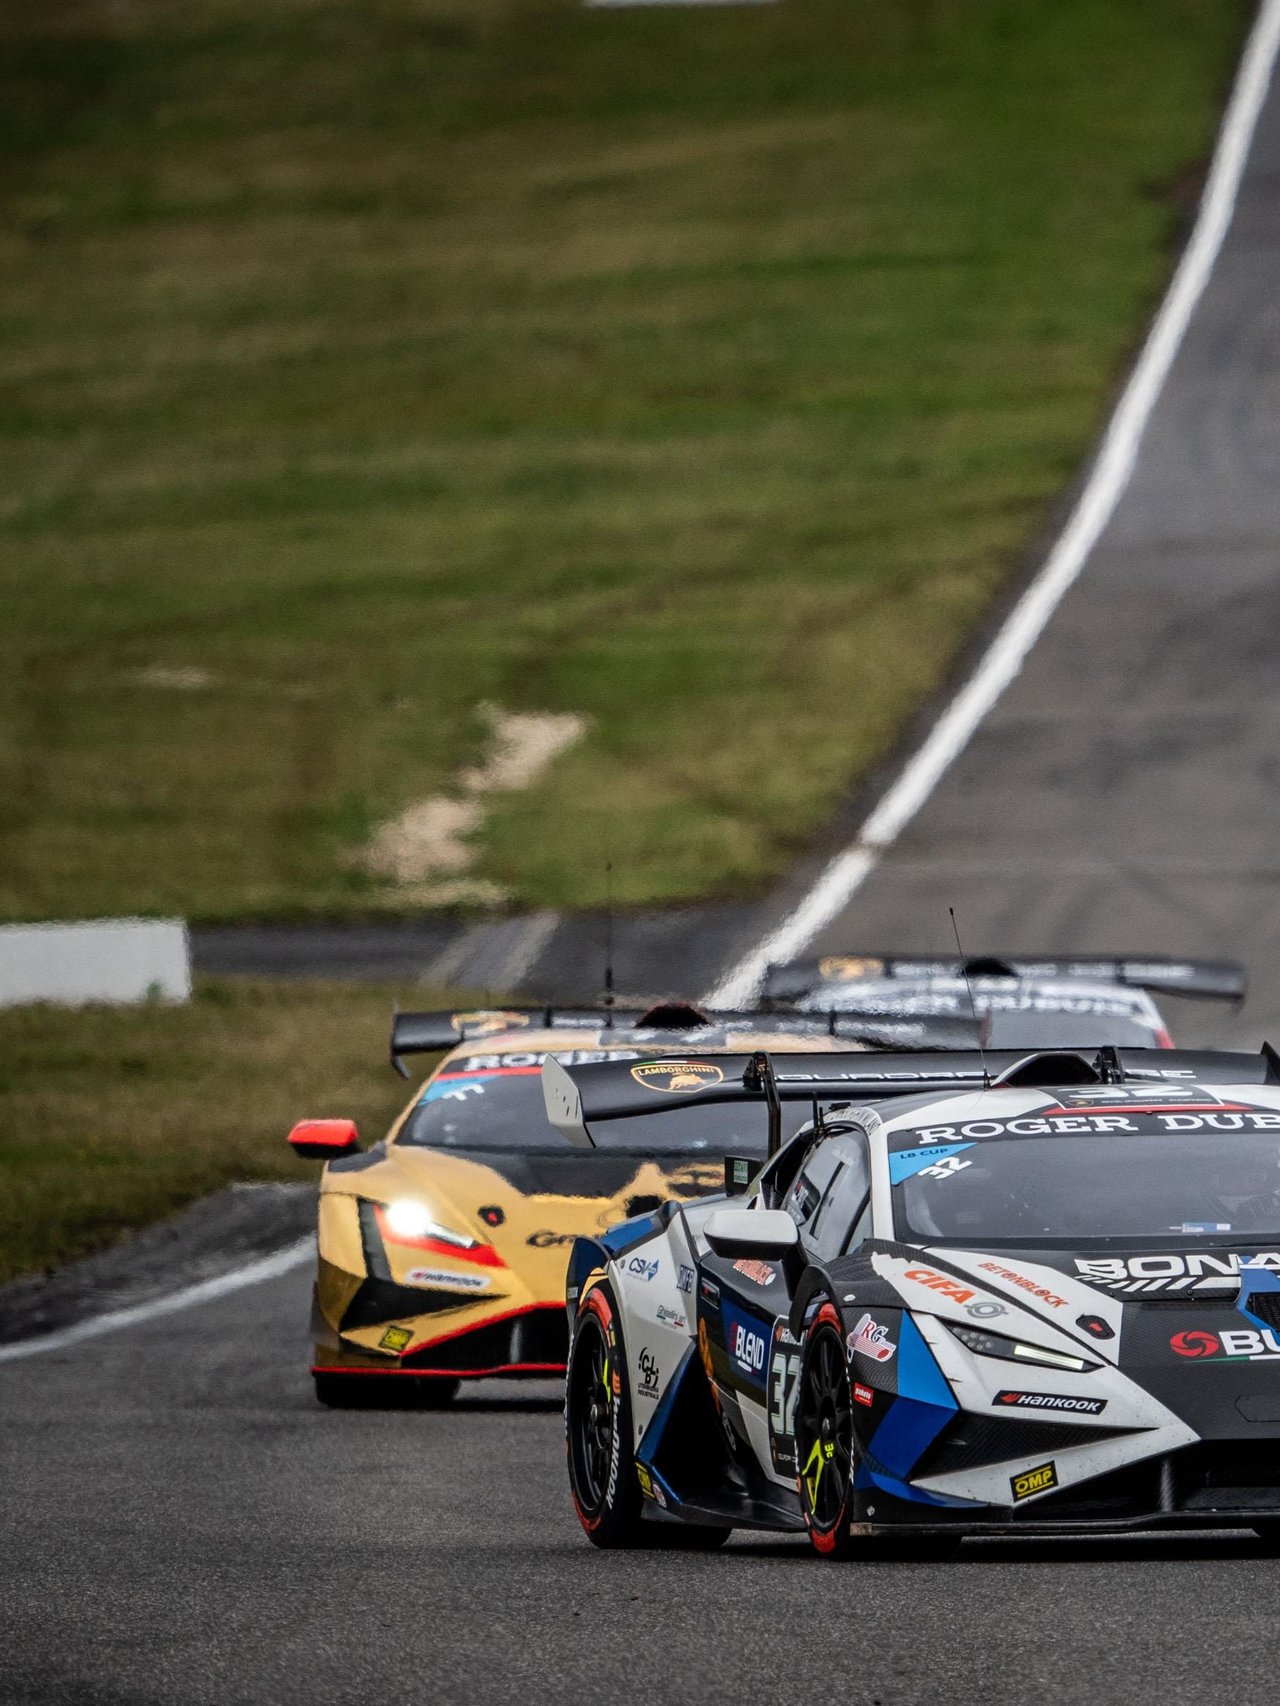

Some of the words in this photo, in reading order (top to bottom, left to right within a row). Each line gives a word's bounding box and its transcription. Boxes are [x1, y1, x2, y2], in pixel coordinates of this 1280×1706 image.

[637, 1065, 716, 1076] LAMBORGHINI
[772, 1071, 990, 1081] QUADRA
[1057, 1085, 1194, 1100] 32
[916, 1116, 1139, 1144] ROGER
[920, 1147, 948, 1157] CUP
[917, 1157, 972, 1180] 32
[903, 1269, 976, 1304] CIFA
[977, 1262, 1069, 1309] BETONBLOCK
[862, 1321, 888, 1343] RG
[736, 1325, 764, 1371] BLEND
[770, 1353, 800, 1436] 32
[1015, 1469, 1053, 1493] OMP
